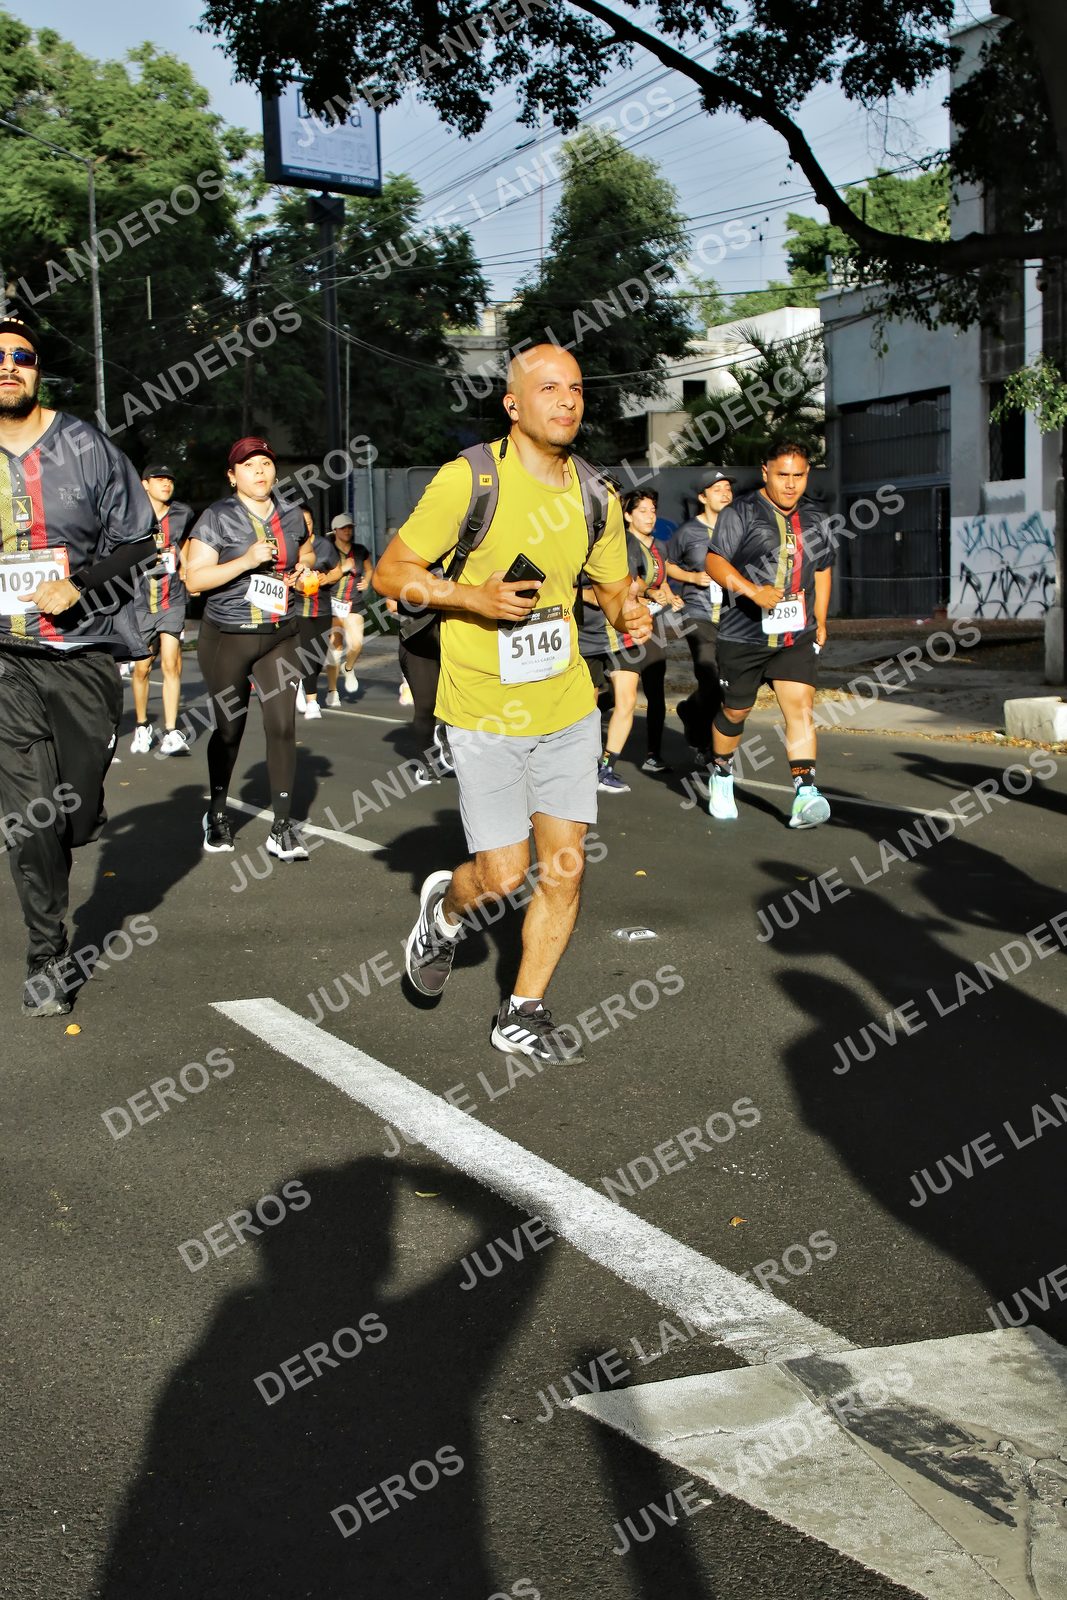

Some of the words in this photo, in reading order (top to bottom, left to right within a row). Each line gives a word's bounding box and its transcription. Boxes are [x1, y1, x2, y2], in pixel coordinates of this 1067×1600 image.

[253, 579, 285, 600] 12048
[769, 605, 798, 620] 9289
[511, 628, 562, 659] 5146
